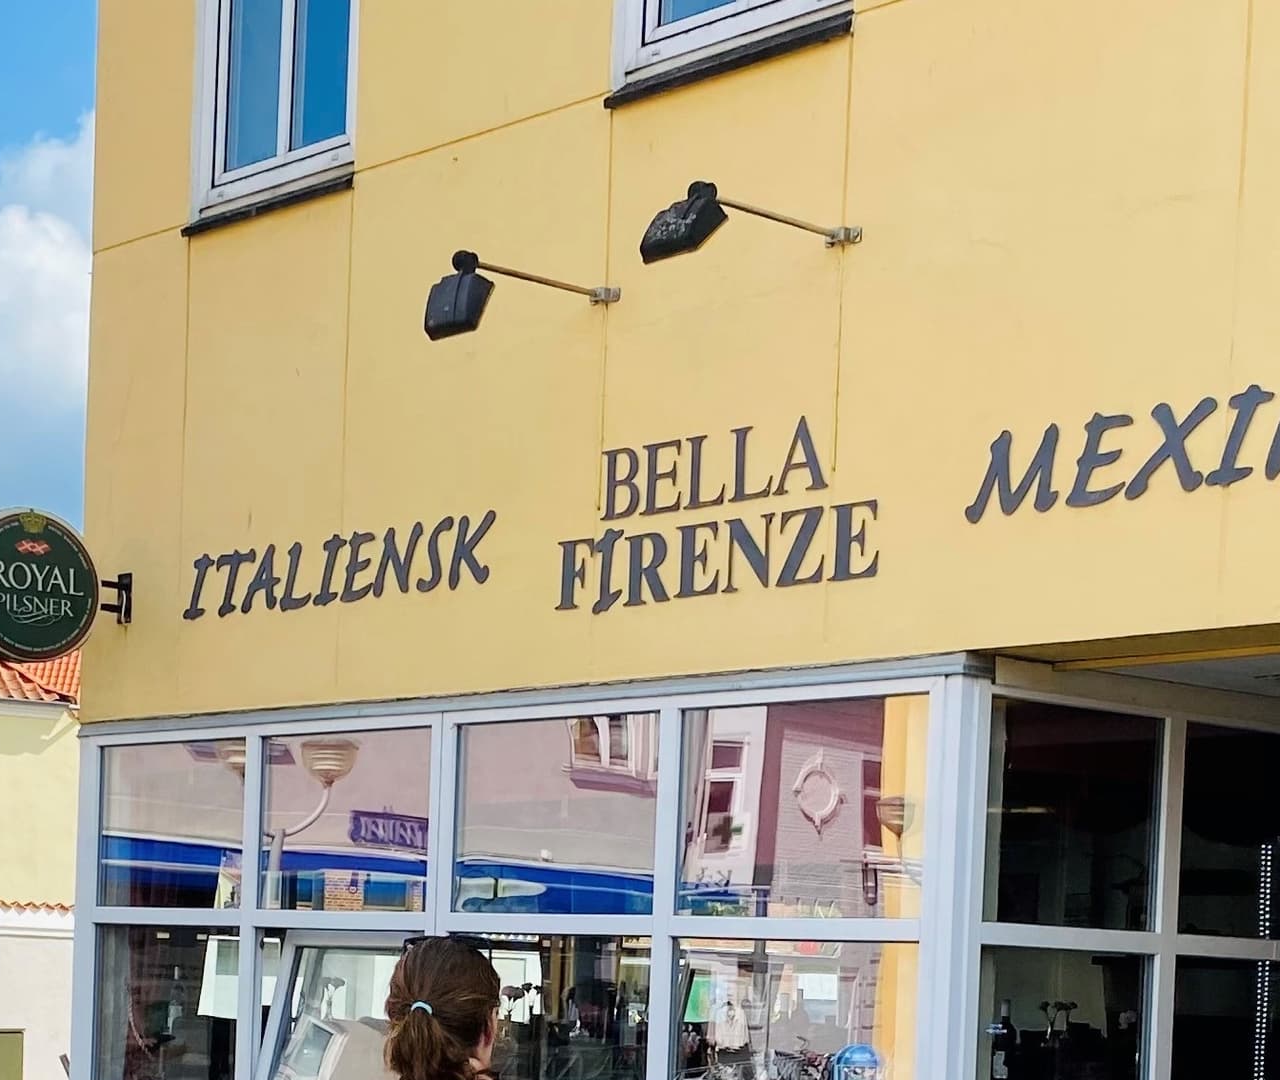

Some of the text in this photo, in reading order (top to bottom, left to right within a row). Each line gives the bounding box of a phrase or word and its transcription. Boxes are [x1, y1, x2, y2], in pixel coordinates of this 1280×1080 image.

[600, 415, 829, 522] BELLA
[182, 510, 496, 620] ITALIENSK
[555, 499, 880, 615] FIRENZE
